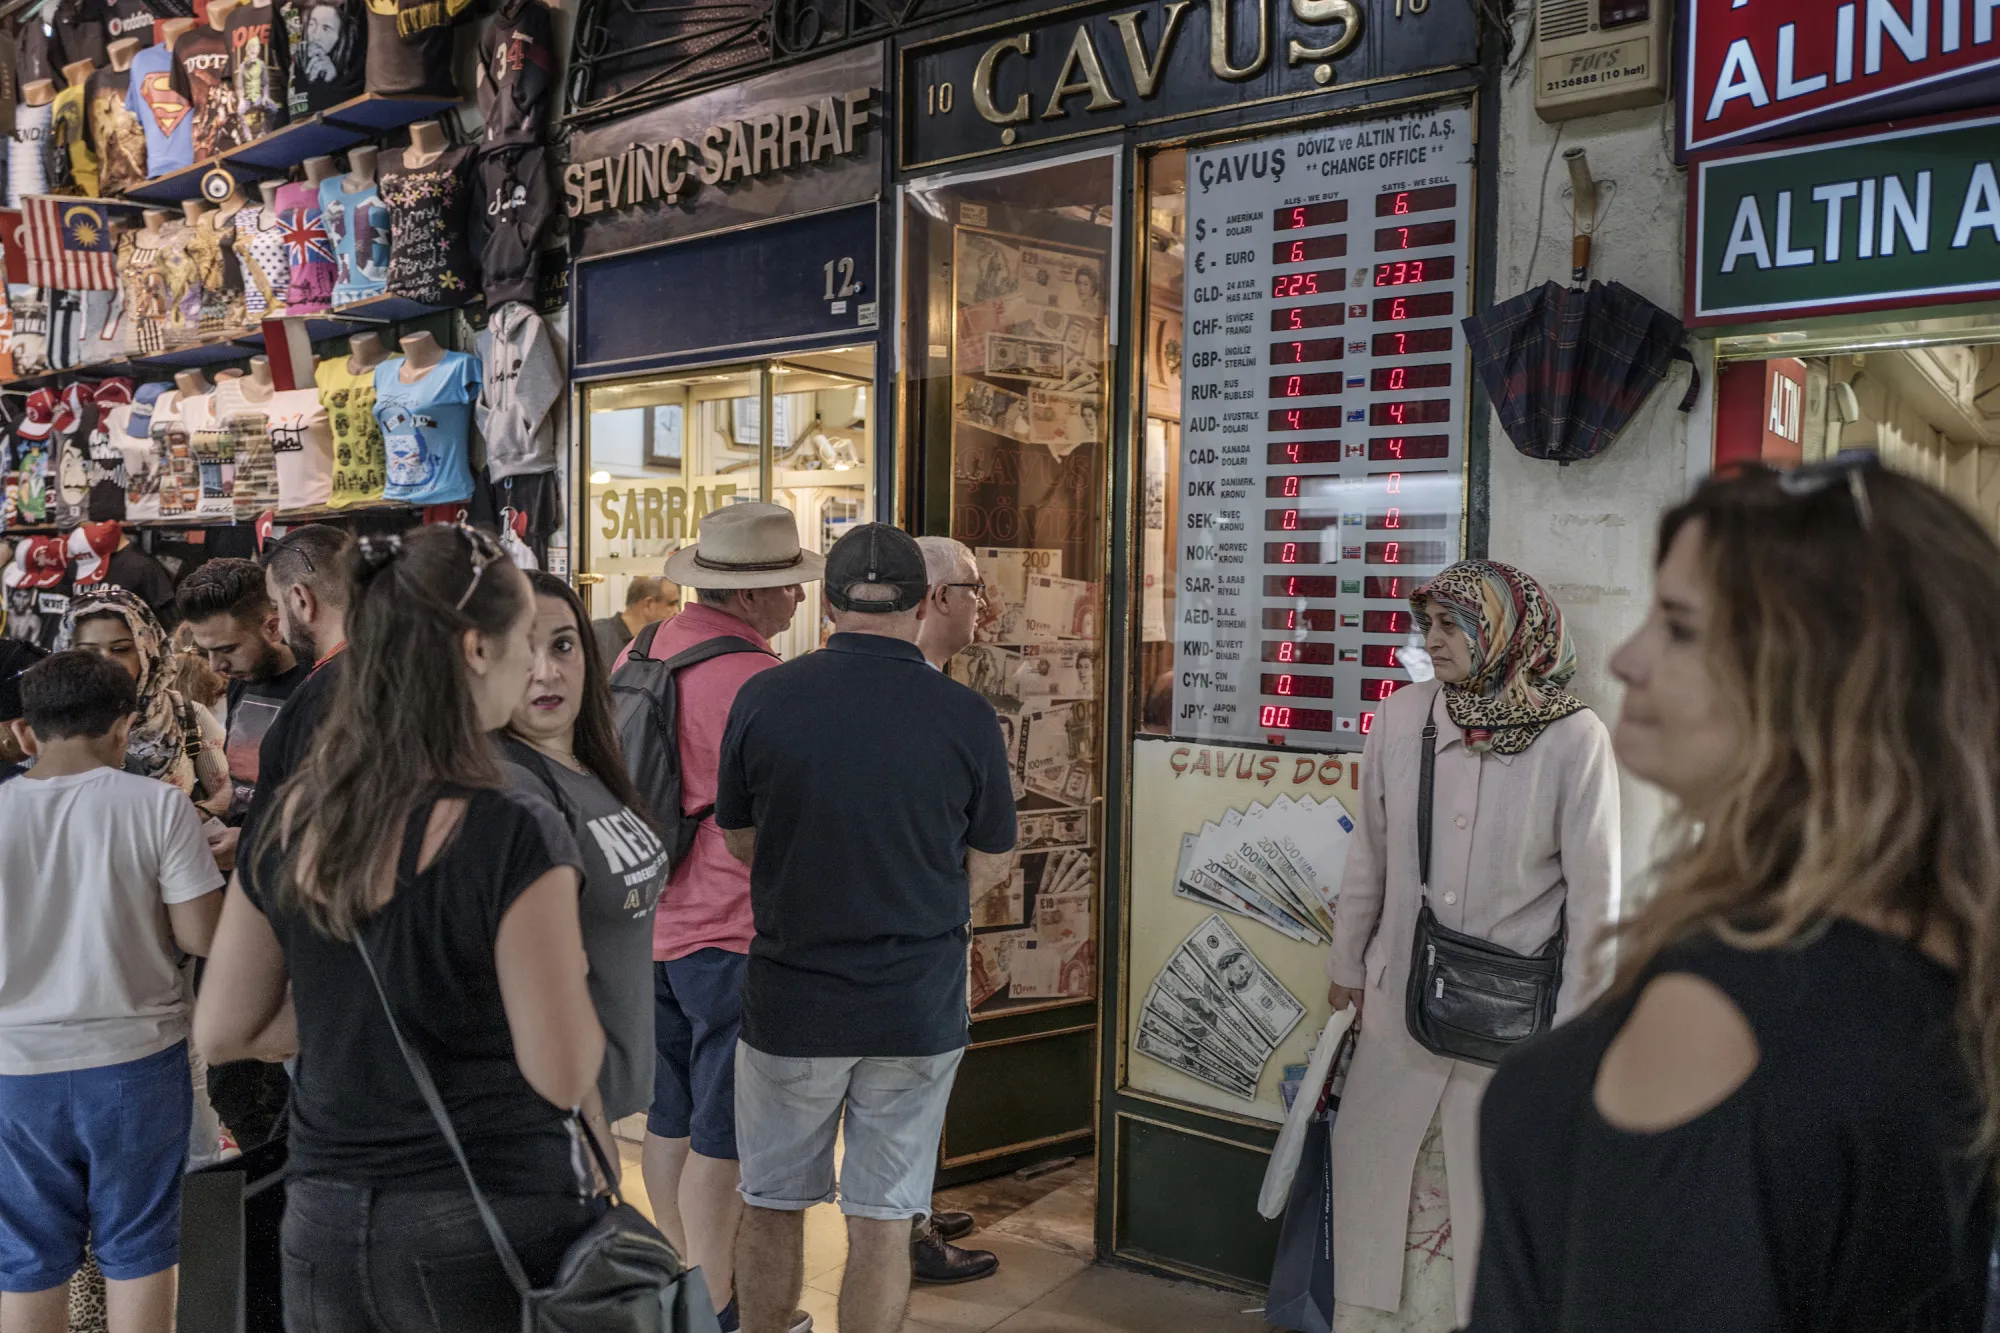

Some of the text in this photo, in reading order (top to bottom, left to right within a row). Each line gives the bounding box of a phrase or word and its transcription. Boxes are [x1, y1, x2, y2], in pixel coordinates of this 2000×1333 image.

[971, 0, 1363, 146] ÇAVUŞ
[1547, 64, 1645, 91] 2136888 (10 hat)
[928, 82, 953, 116] 10
[1297, 119, 1455, 158] DÖVİZ ve ALTIN TİC. A.Ş.
[563, 137, 687, 218] SEVİNÇ
[700, 88, 871, 186] SARRAF
[1322, 147, 1426, 177] CHANGE OFFICE
[1200, 149, 1286, 193] ÇAVUŞ
[1413, 179, 1427, 188] WE
[1429, 176, 1450, 185] SELL
[1308, 193, 1321, 202] WE
[1323, 191, 1339, 200] BUY
[1196, 217, 1206, 243] $
[1719, 168, 1933, 275] ALTIN
[1195, 251, 1205, 274] €
[824, 257, 854, 300] 12
[1769, 371, 1801, 444] ALTIN
[1188, 481, 1215, 496] DKK
[1022, 551, 1050, 568] 200
[1170, 748, 1280, 787] ÇAVUŞ
[1240, 842, 1259, 863] 100
[1257, 837, 1278, 860] 200
[1280, 835, 1300, 859] 500
[1204, 859, 1218, 874] 20
[1222, 853, 1238, 870] 50
[1190, 869, 1202, 883] 10
